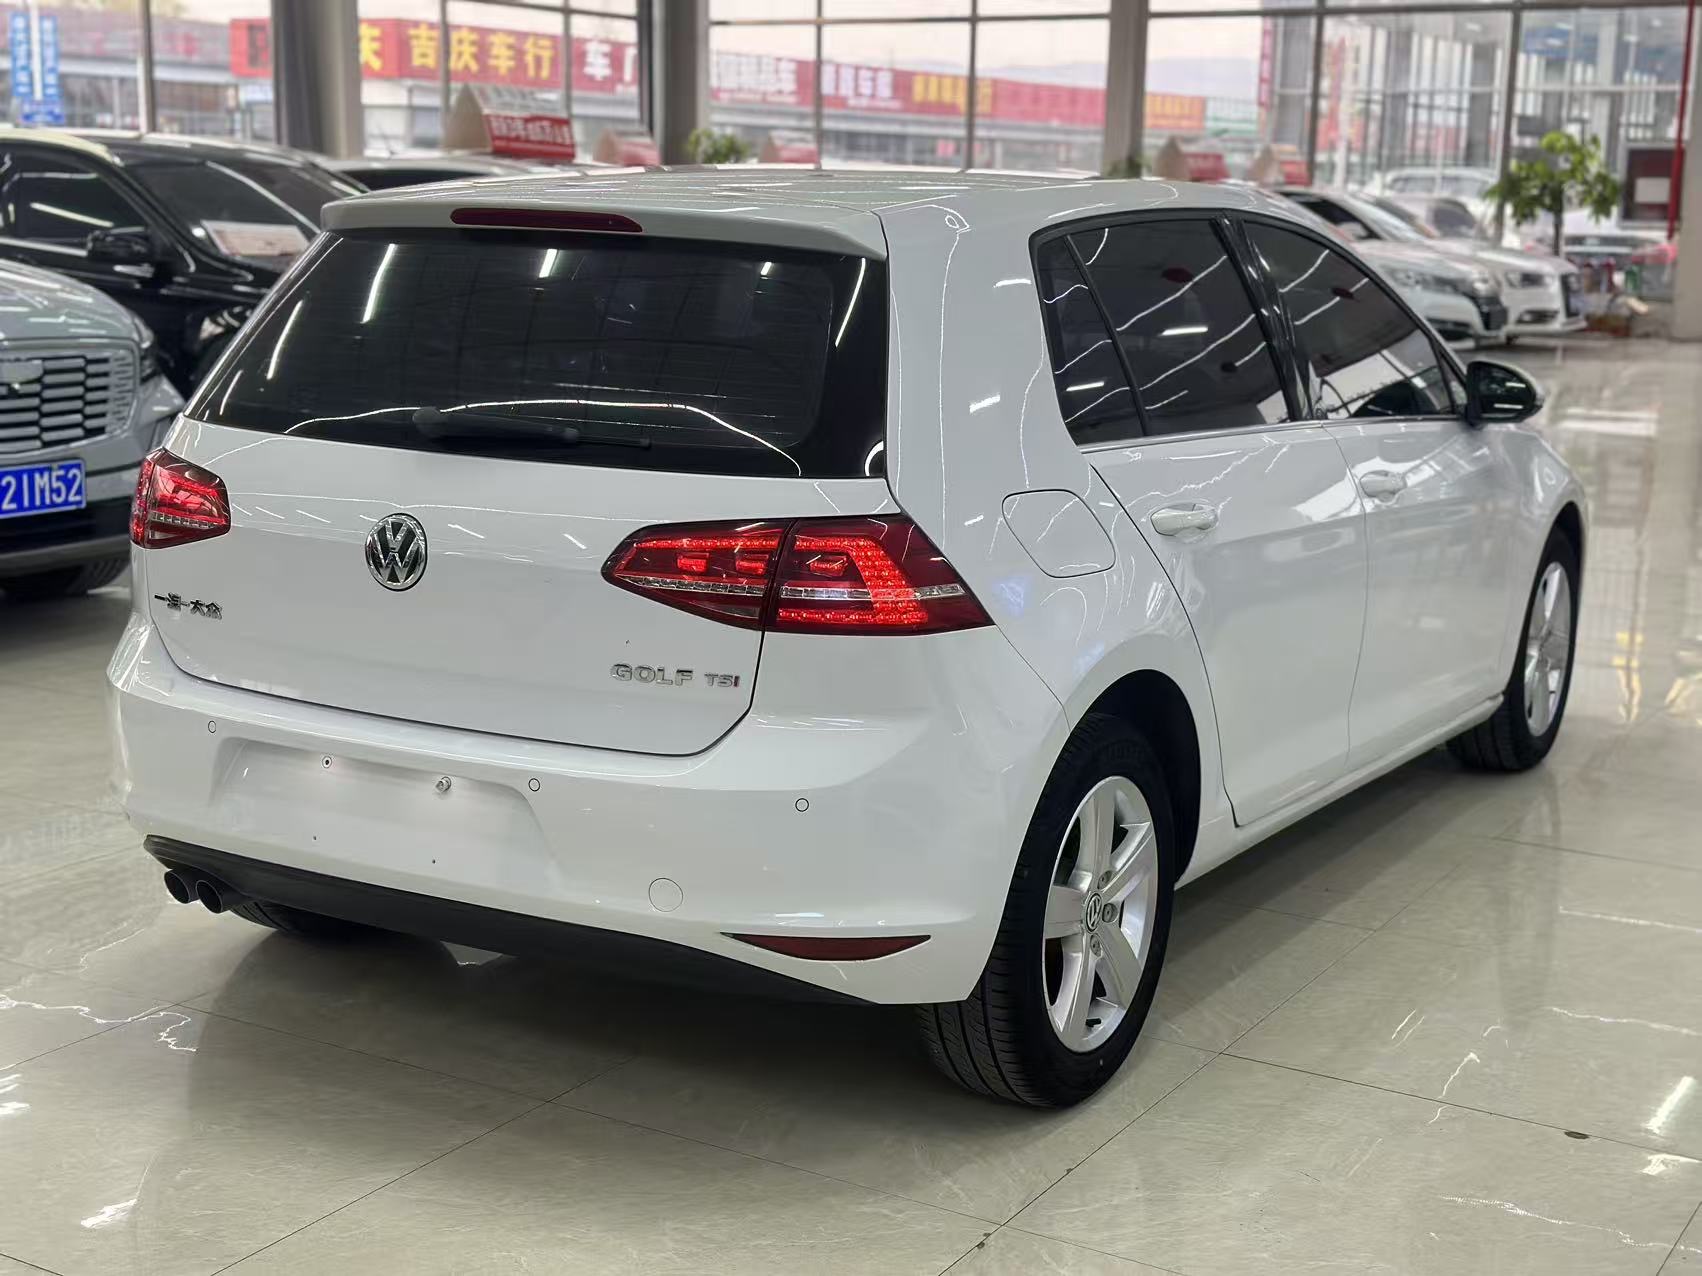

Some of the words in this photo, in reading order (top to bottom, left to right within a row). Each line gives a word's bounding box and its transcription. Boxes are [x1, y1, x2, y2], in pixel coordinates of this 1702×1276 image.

[408, 22, 556, 80] 吉庆车行
[366, 514, 427, 590] VW
[610, 662, 693, 686] GOLF
